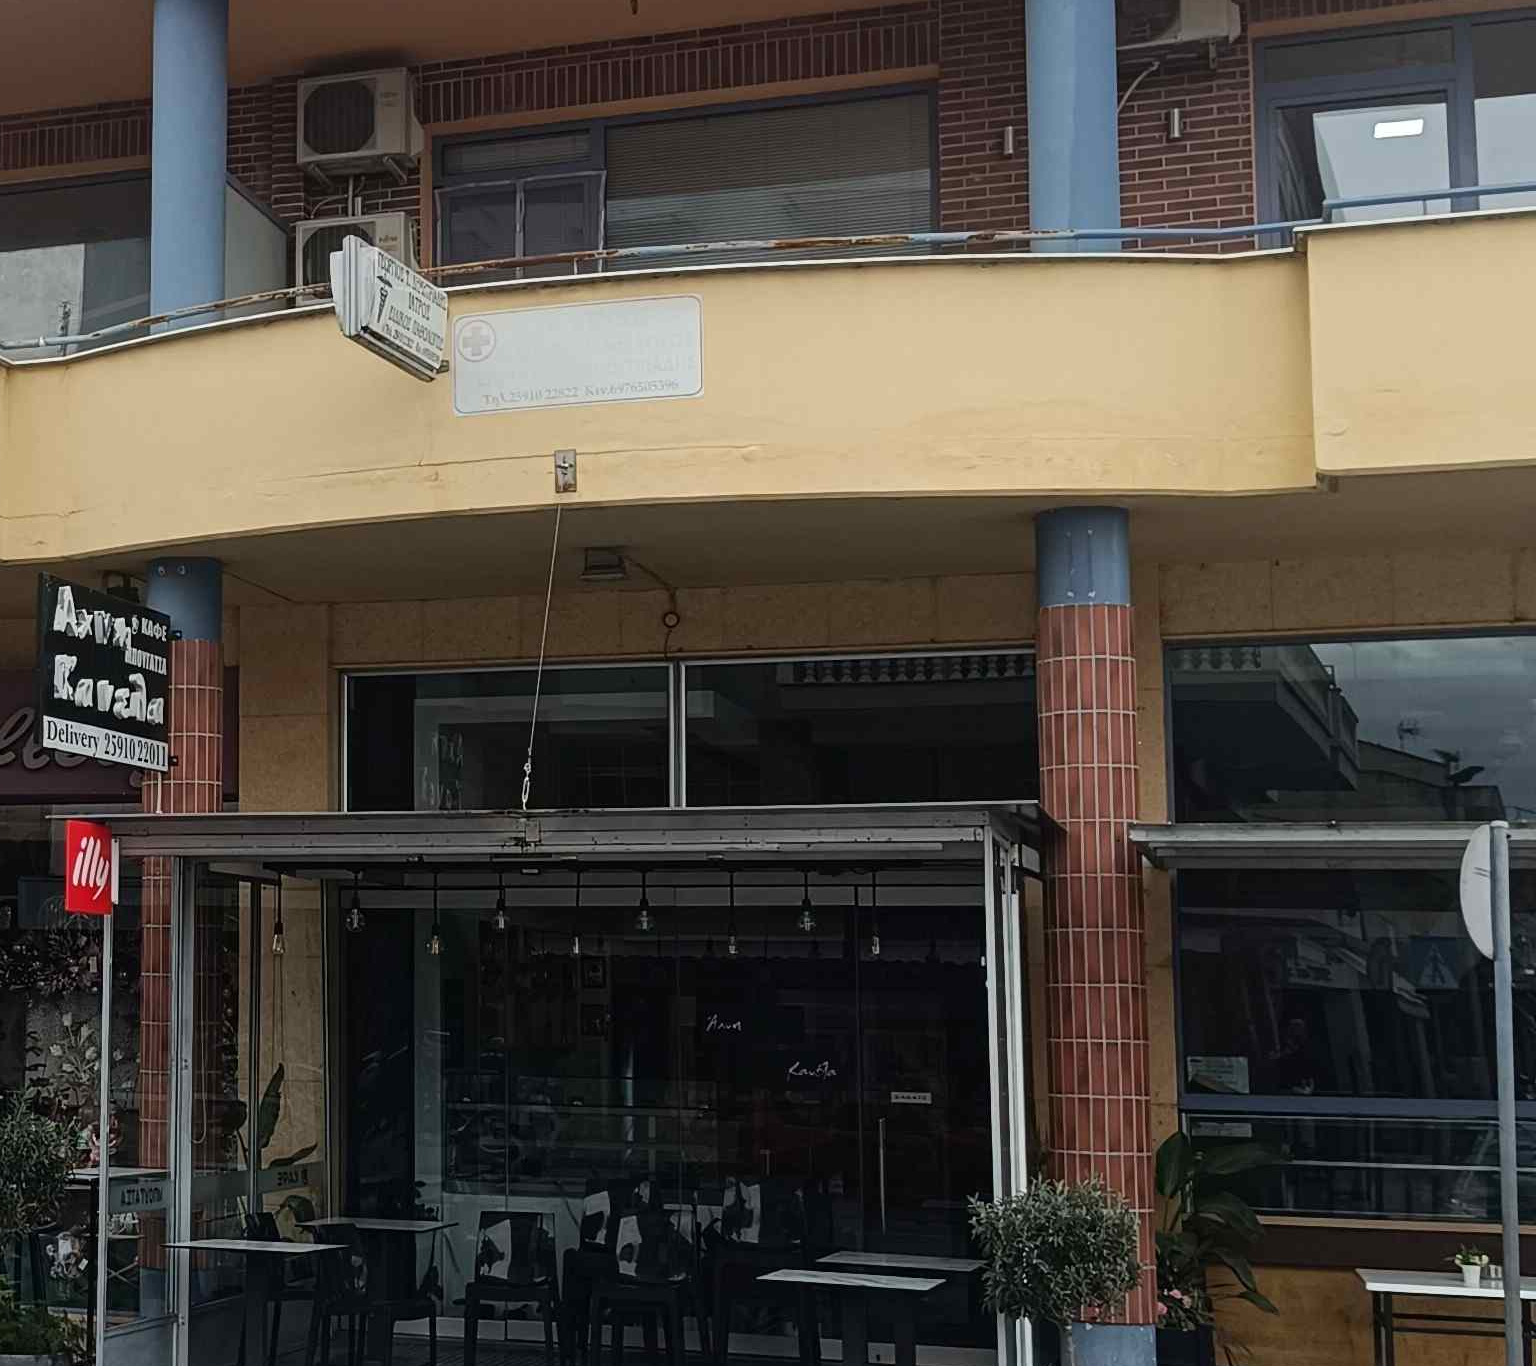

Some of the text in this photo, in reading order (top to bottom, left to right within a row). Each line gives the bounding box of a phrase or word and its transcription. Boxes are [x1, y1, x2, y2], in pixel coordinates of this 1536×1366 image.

[141, 617, 167, 642] ΚΑΦΕ
[47, 720, 166, 768] Delivery 25910 22011
[72, 836, 110, 901] illy
